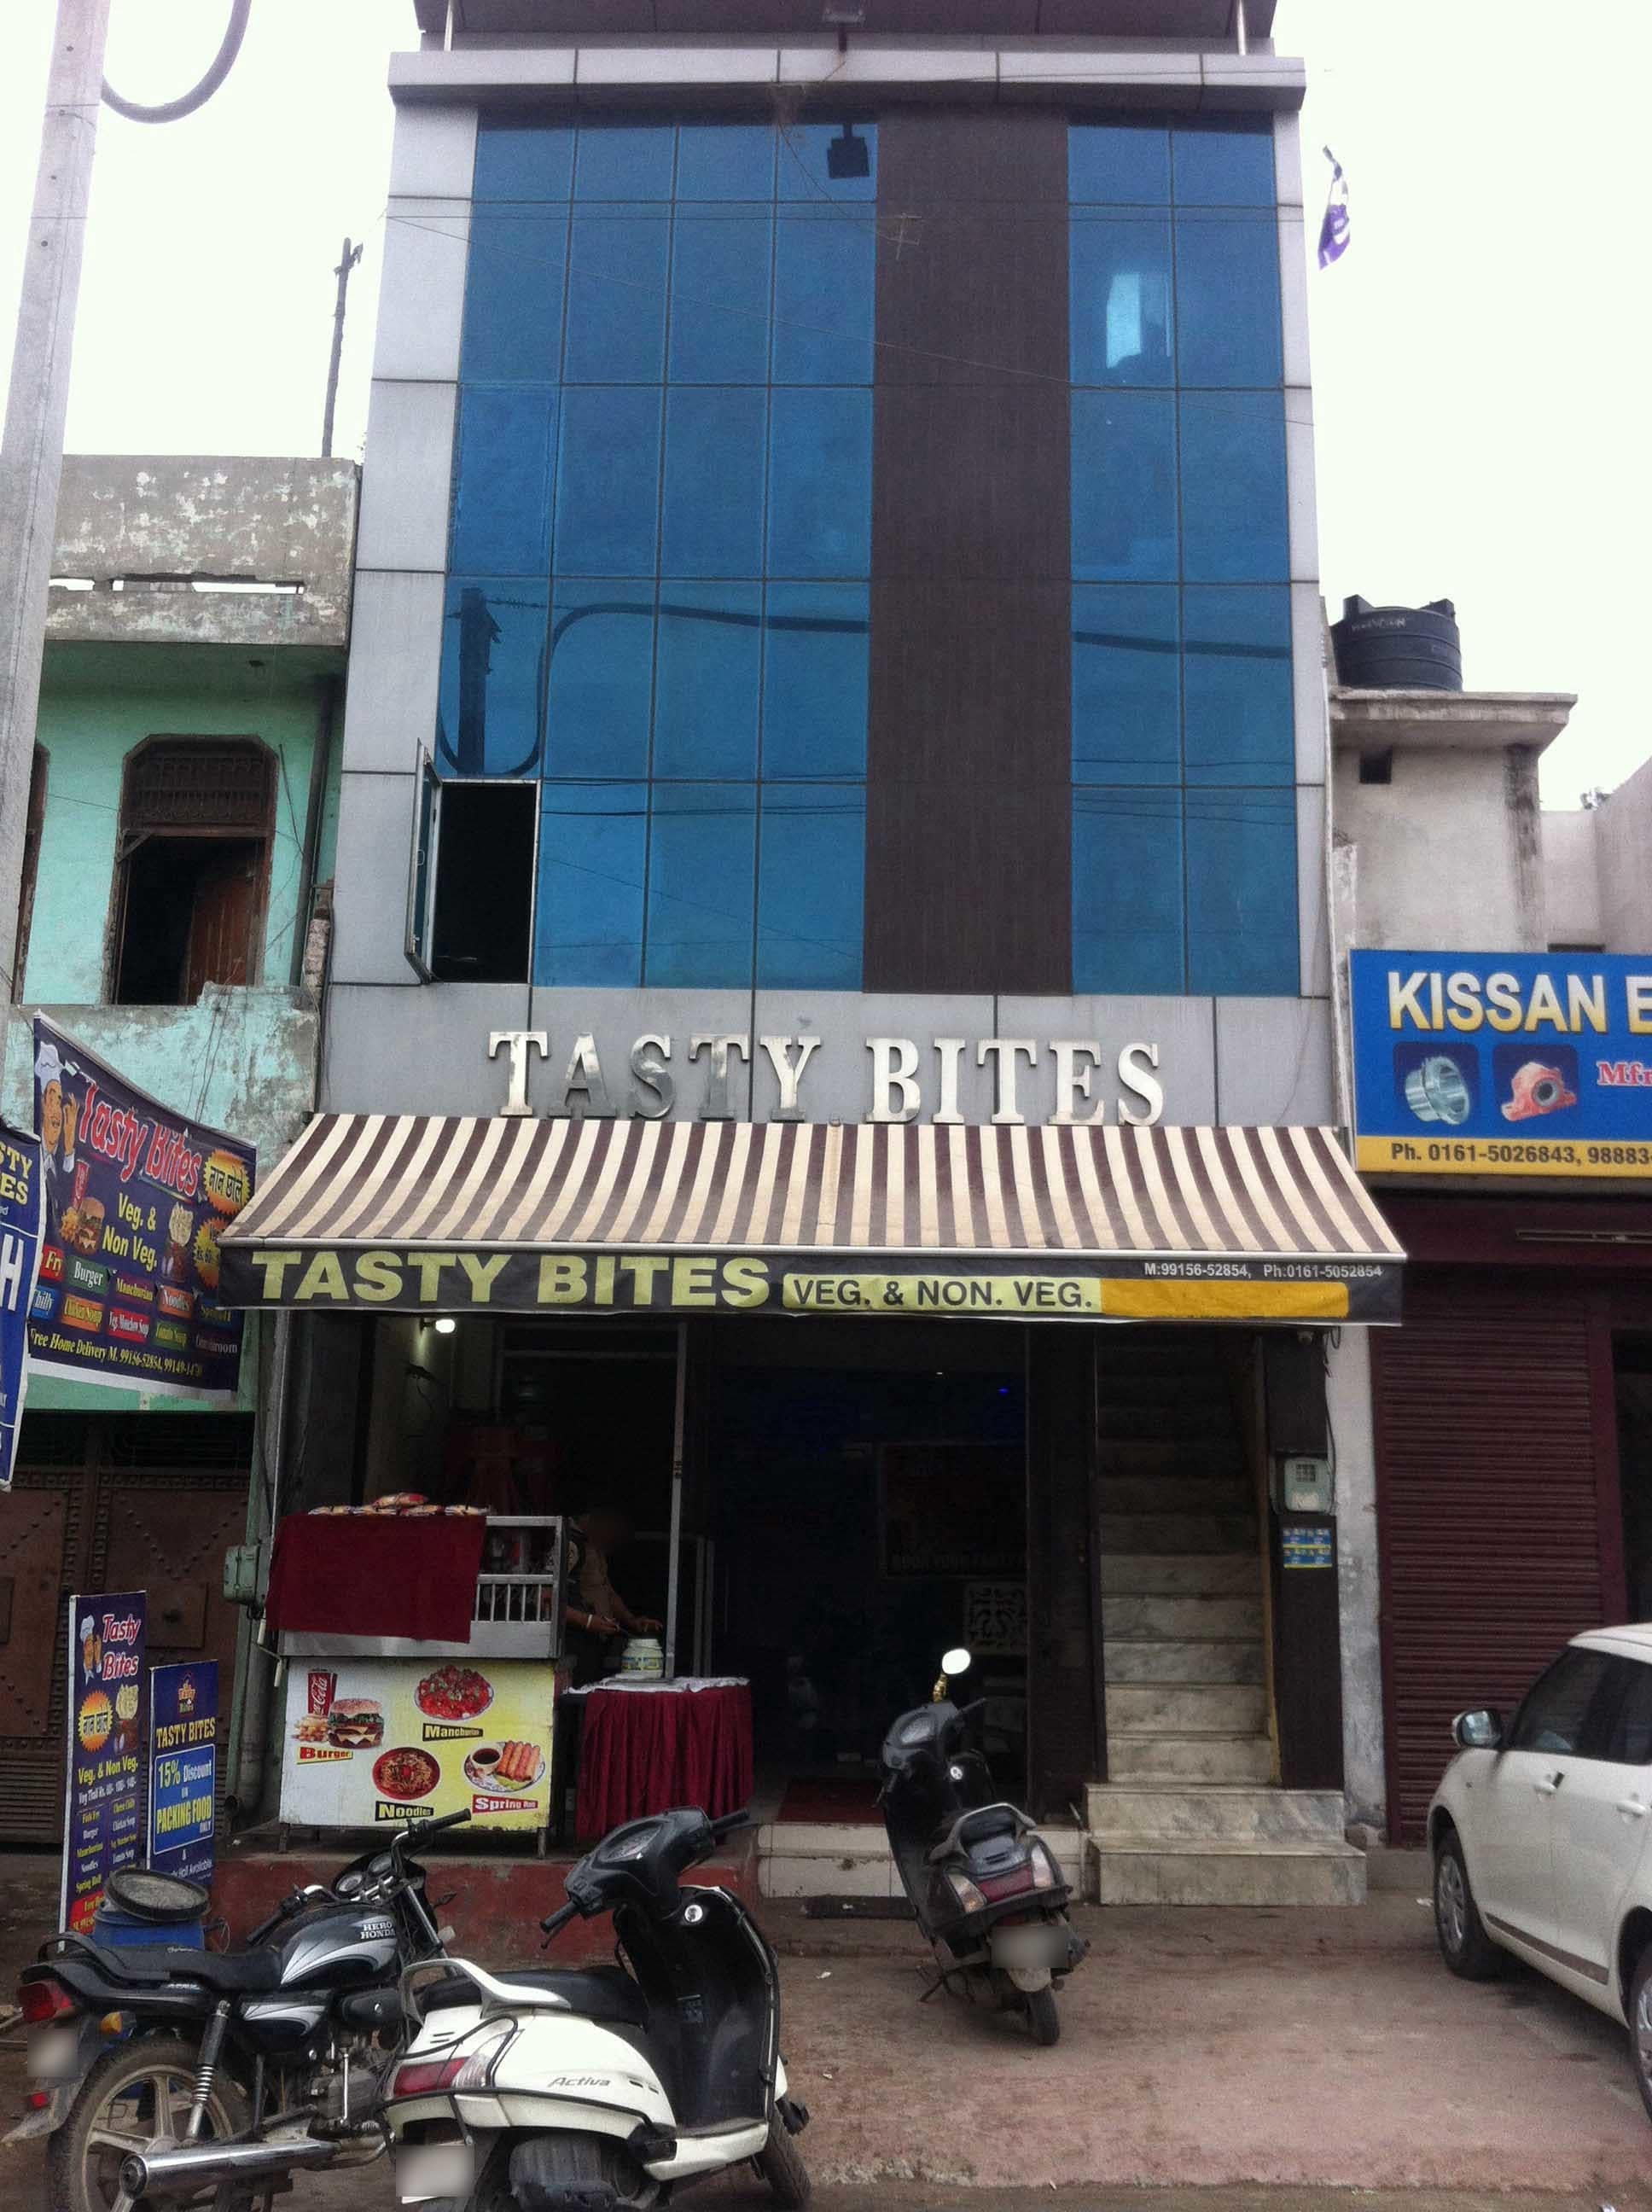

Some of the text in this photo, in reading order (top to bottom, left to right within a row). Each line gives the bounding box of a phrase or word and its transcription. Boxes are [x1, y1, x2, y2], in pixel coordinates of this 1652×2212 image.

[1388, 971, 1608, 1033] KISSAN
[488, 1031, 1166, 1126] TASTY BITES
[79, 1079, 148, 1183] Tasty
[145, 1119, 202, 1197] Bites
[1392, 1143, 1422, 1162] Ph.
[1428, 1144, 1582, 1166] 0161-5026843,
[148, 1207, 156, 1231] &
[102, 1226, 128, 1258] Non
[73, 1260, 104, 1288] Burger
[252, 1250, 770, 1307] TASTY BITES
[1144, 1262, 1383, 1279] M:99156-52854, Ph:0161-5052854
[162, 1288, 190, 1312] Noodles
[793, 1279, 1092, 1307] VEG. & NON. VEG.
[49, 1333, 76, 1353] Home
[76, 1338, 108, 1363] Delivery
[102, 1613, 142, 1645] Tasty
[102, 1651, 140, 1681] Bites
[156, 1716, 216, 1749] TASTY BITES
[300, 1746, 351, 1760] Burger
[105, 1760, 120, 1777] Non
[158, 1759, 181, 1789] 15%
[183, 1760, 212, 1783] Discount
[156, 1801, 191, 1834] PACKING
[192, 1795, 212, 1824] FOOD
[378, 1803, 431, 1818] Noodles
[474, 1797, 522, 1810] Spring
[360, 1928, 396, 1940] HONDA
[363, 1921, 393, 1931] HERO
[547, 2076, 612, 2087] Activa
